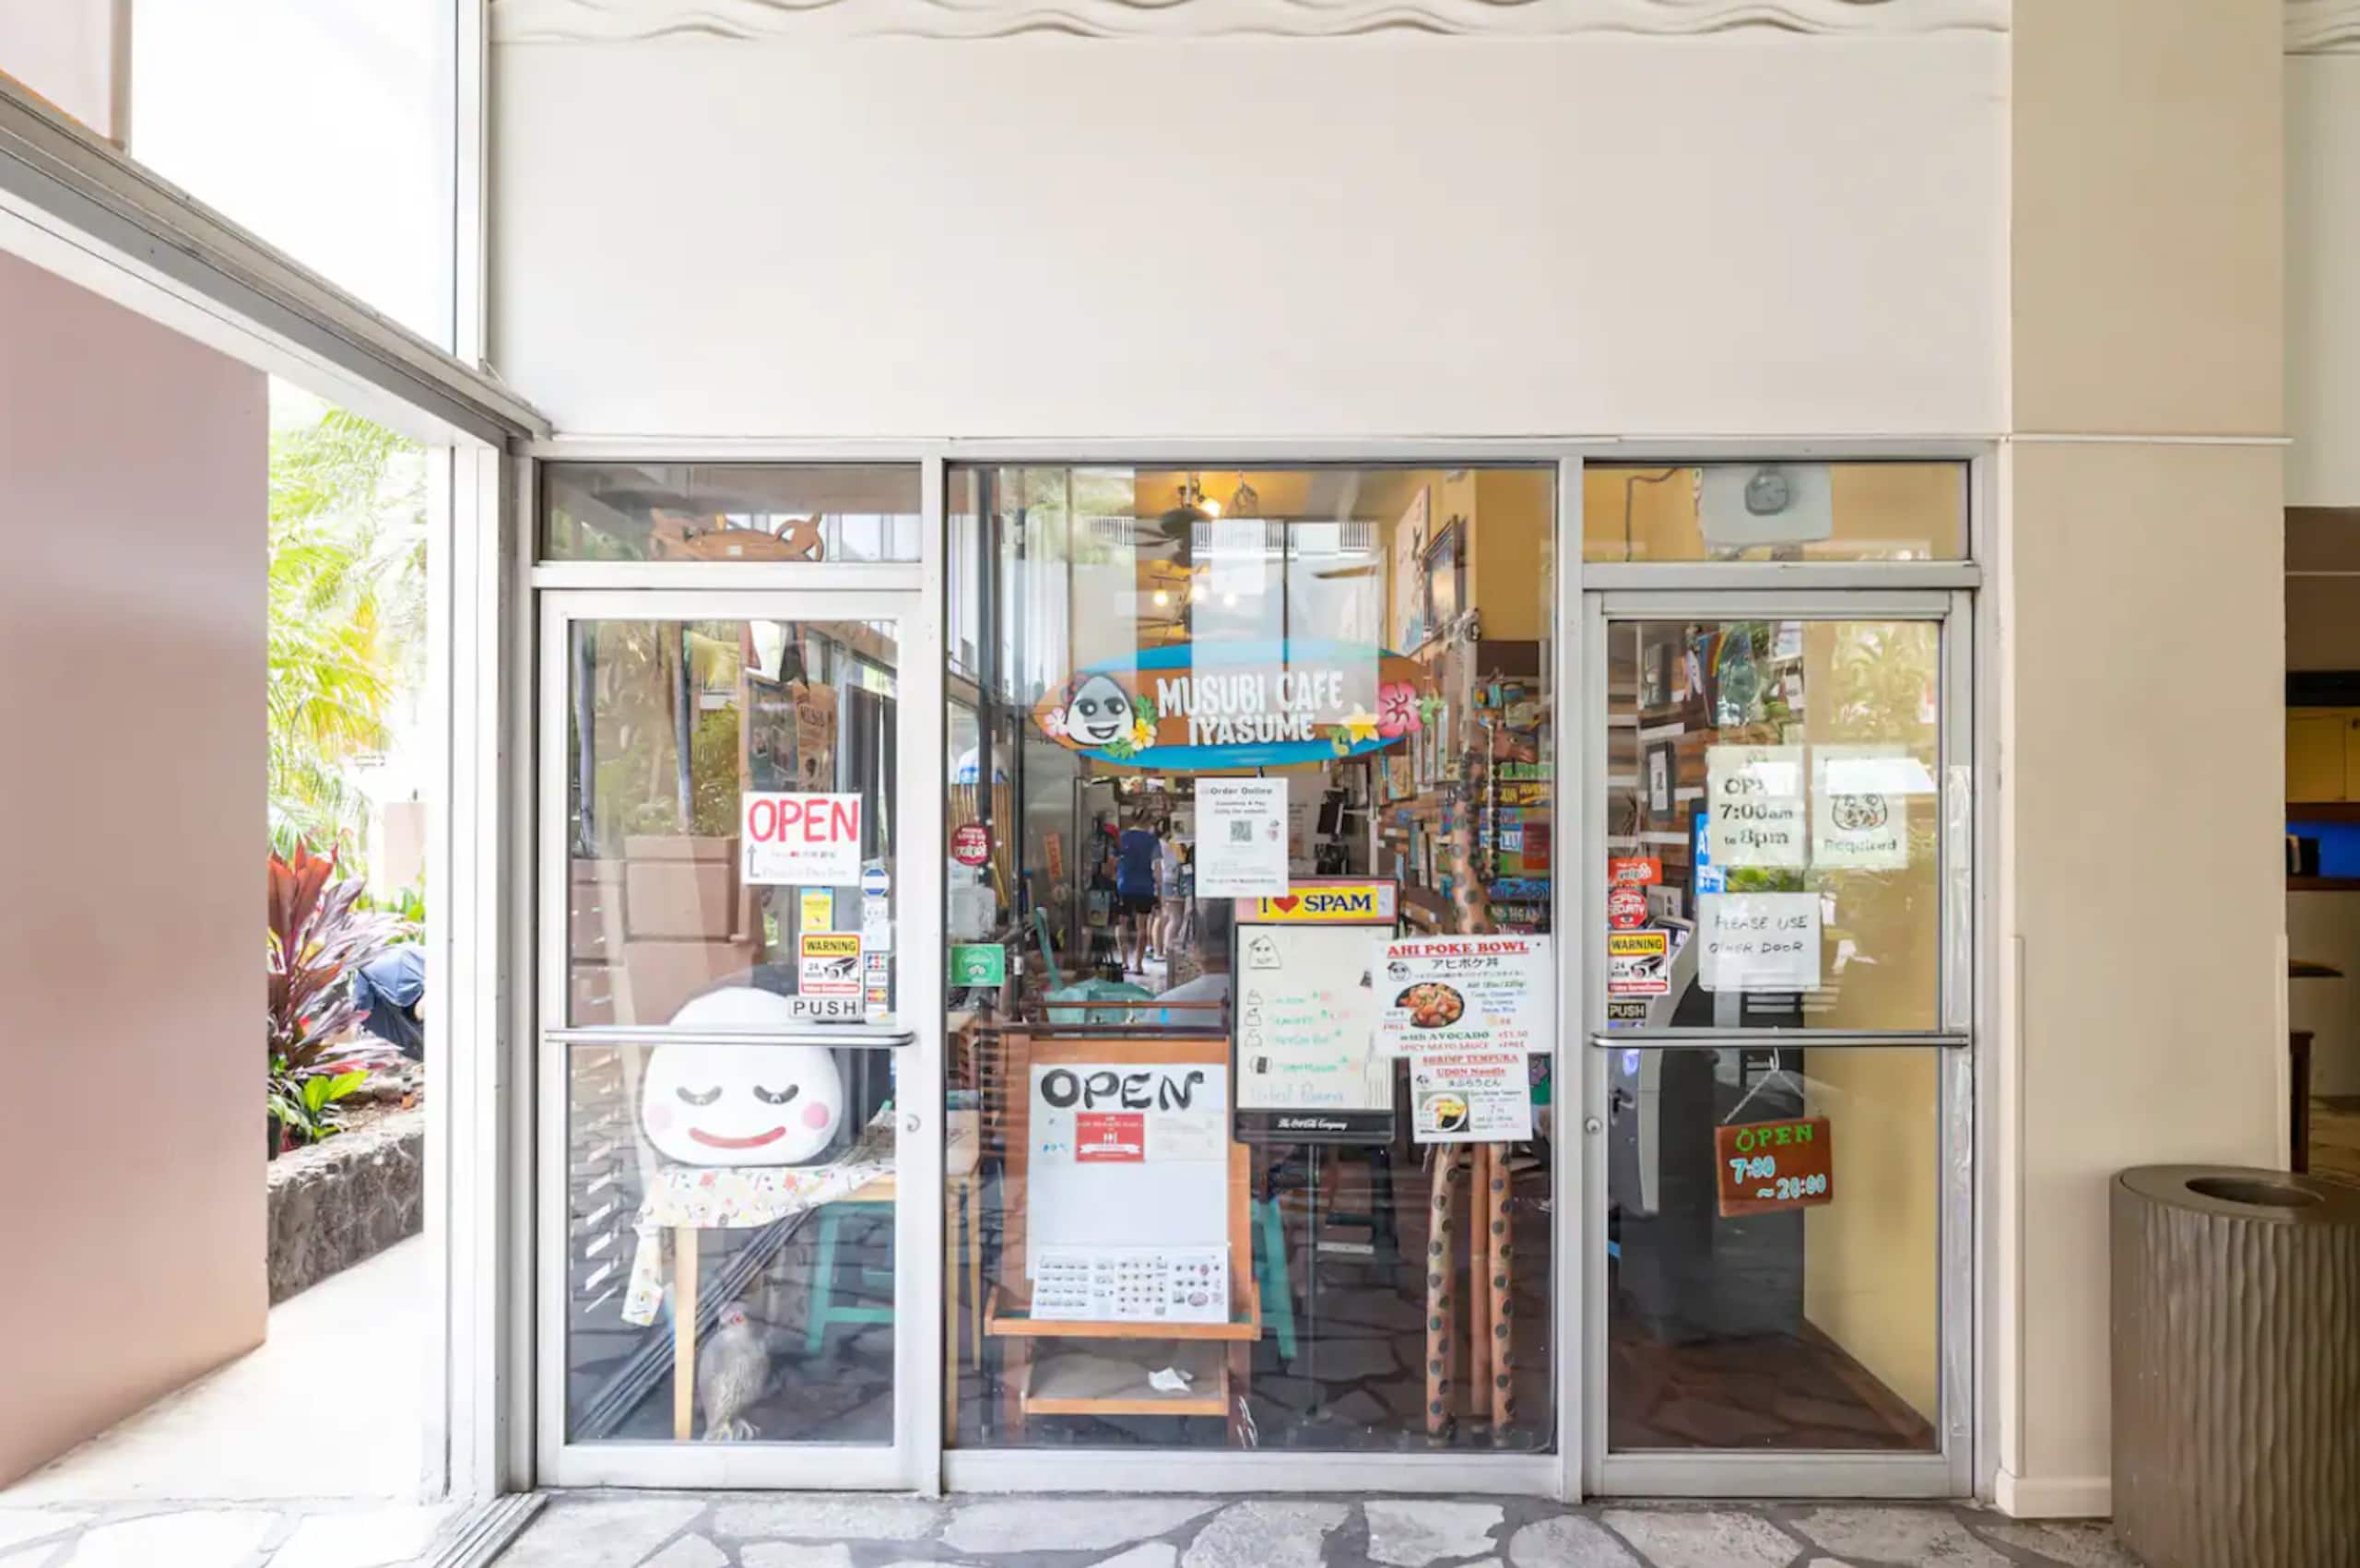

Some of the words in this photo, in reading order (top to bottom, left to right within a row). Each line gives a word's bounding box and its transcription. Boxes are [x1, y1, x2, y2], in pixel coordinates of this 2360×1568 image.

[1156, 674, 1265, 718] MUSUBI
[1276, 671, 1344, 713] CAFE
[1187, 713, 1316, 746] IYASUME
[1210, 786, 1238, 796] Order
[1241, 786, 1273, 796] Online
[1719, 803, 1794, 819] 7:00am
[749, 799, 858, 843] OPEN
[1262, 897, 1268, 914] I
[1304, 893, 1372, 913] SPAM
[1777, 914, 1808, 929] USE
[806, 939, 857, 952] WARNING
[1387, 944, 1420, 956] AHI
[1425, 942, 1472, 955] POKE
[1478, 941, 1529, 953] BOWL
[1611, 938, 1663, 951] WARNING
[1760, 941, 1803, 953] DOOR
[793, 1001, 857, 1015] PUSH
[1610, 1005, 1646, 1018] PUSH
[1429, 1032, 1490, 1041] AVOCADO
[1467, 1054, 1519, 1064] TEMPURA
[1436, 1068, 1468, 1077] UDON
[1041, 1067, 1204, 1111] OPEN
[1736, 1124, 1813, 1152] OPEN
[1729, 1155, 1776, 1185] 7:00
